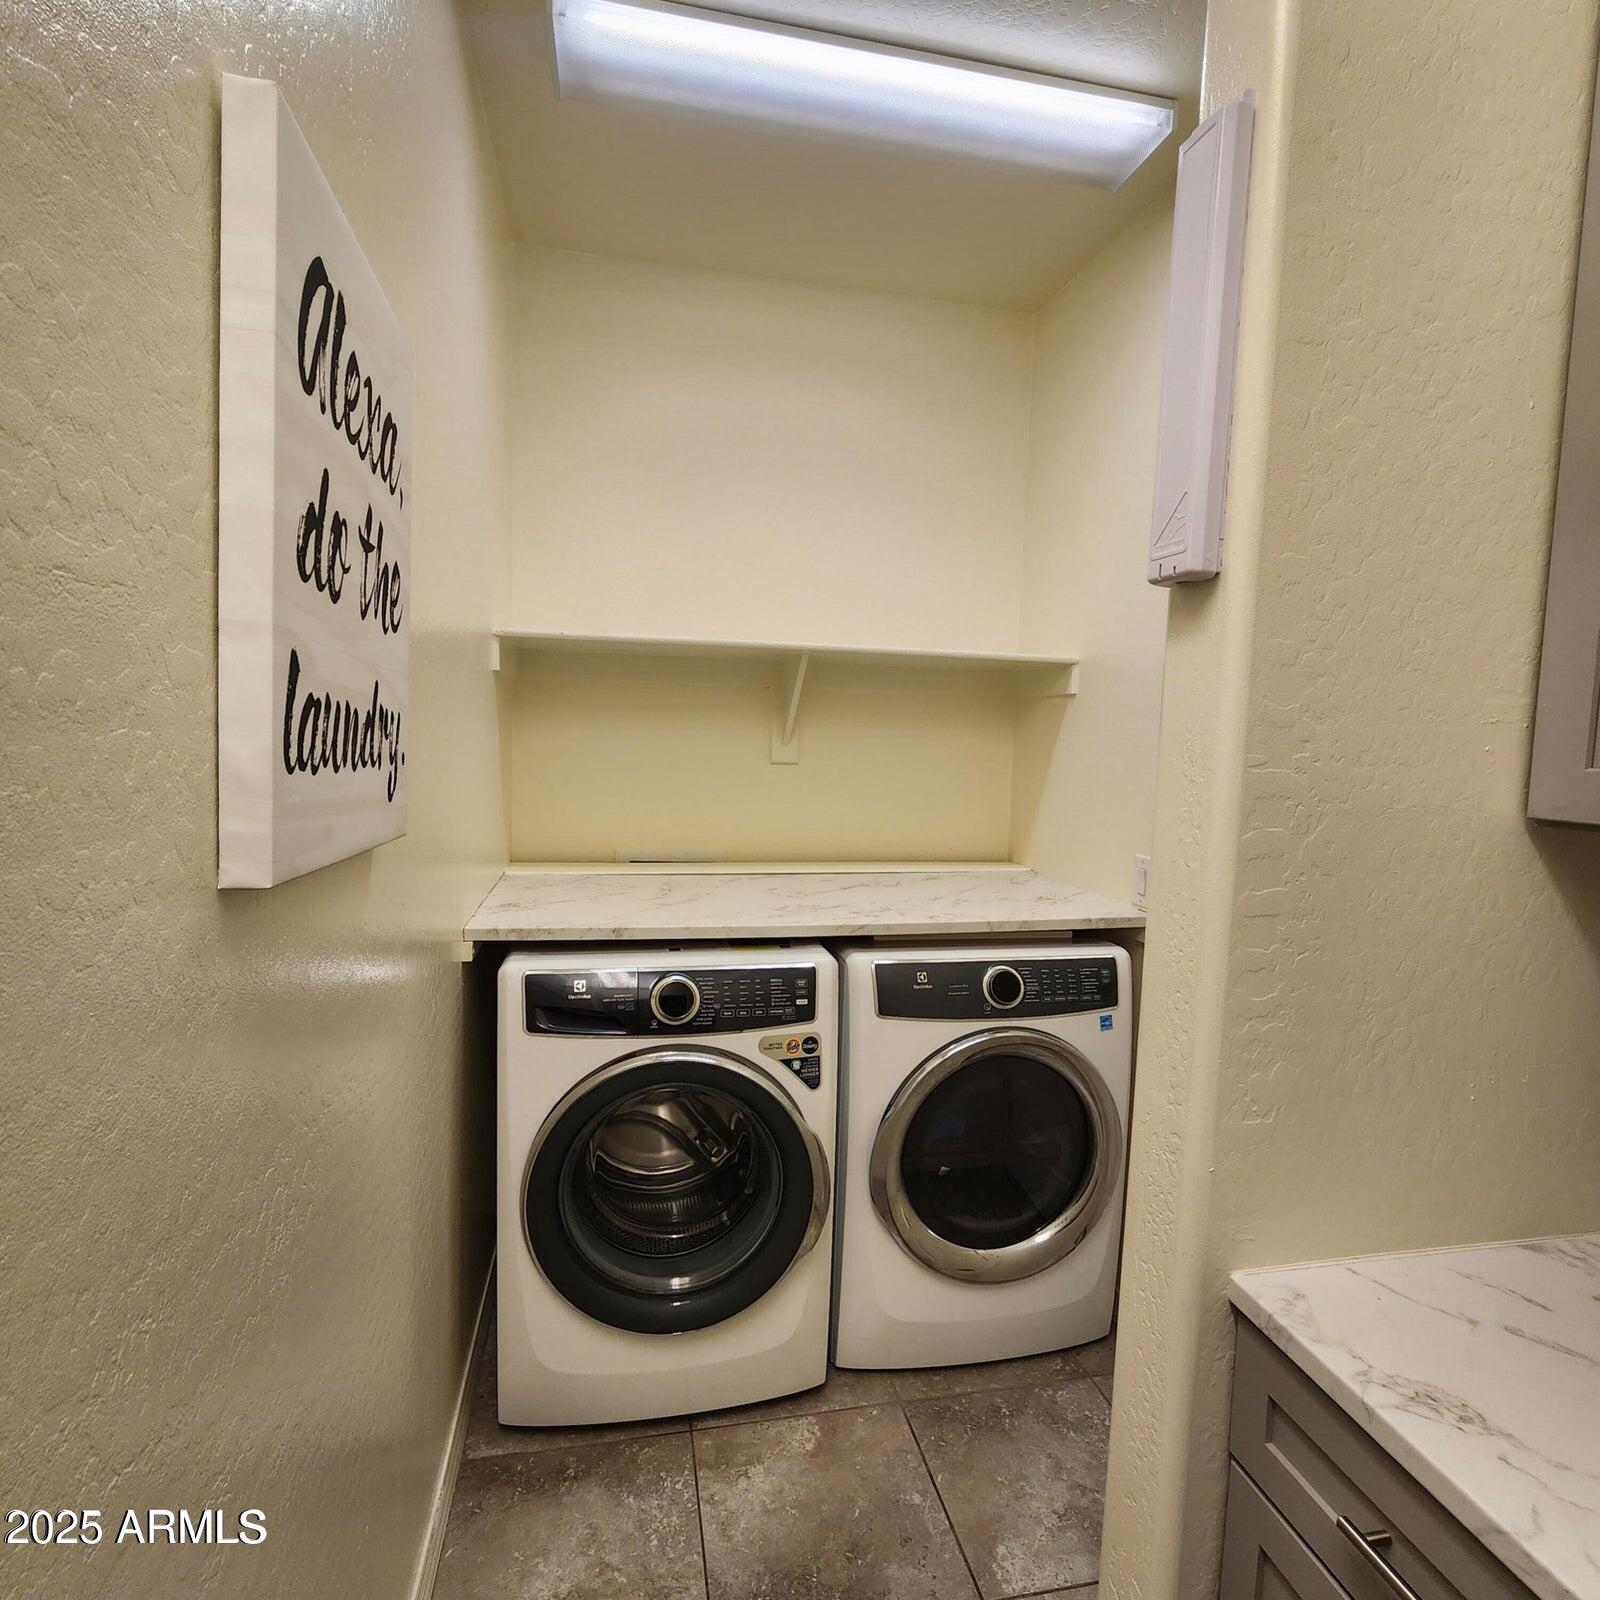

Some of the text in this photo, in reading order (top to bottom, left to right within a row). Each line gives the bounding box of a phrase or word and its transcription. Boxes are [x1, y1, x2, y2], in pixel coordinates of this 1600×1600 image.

[298, 256, 405, 510] Alexa,
[297, 467, 403, 635] do the
[283, 647, 405, 803] laundry.
